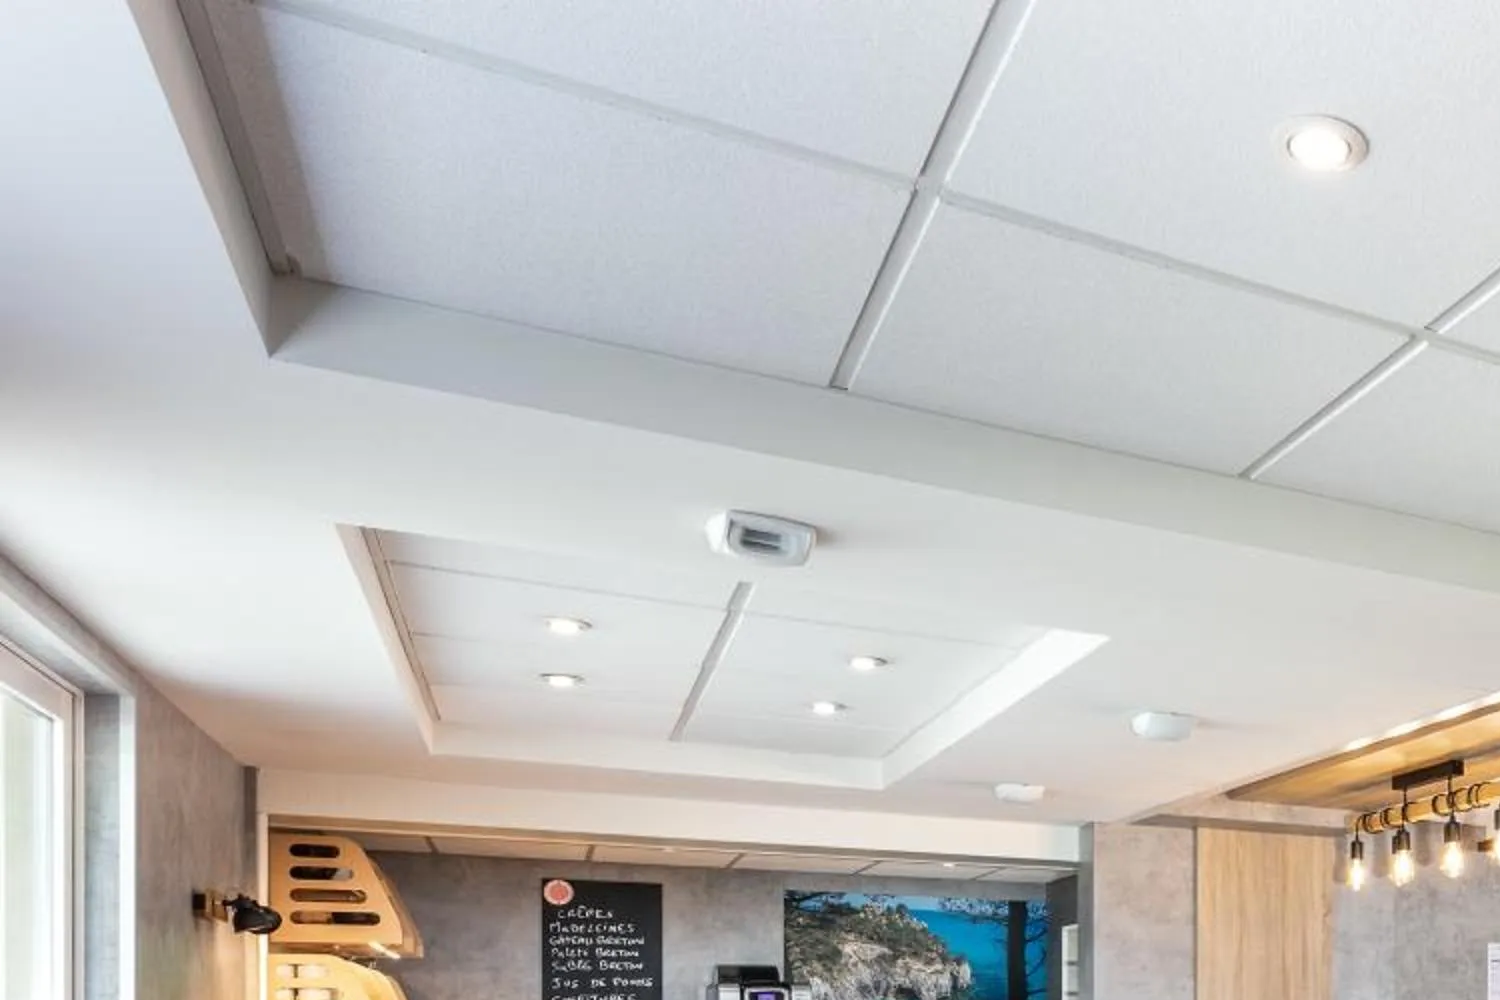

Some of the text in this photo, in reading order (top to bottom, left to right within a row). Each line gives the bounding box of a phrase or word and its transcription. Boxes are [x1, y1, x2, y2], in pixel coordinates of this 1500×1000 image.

[549, 921, 636, 934] MADELEINES
[551, 977, 579, 989] JUS
[591, 977, 607, 988] DE
